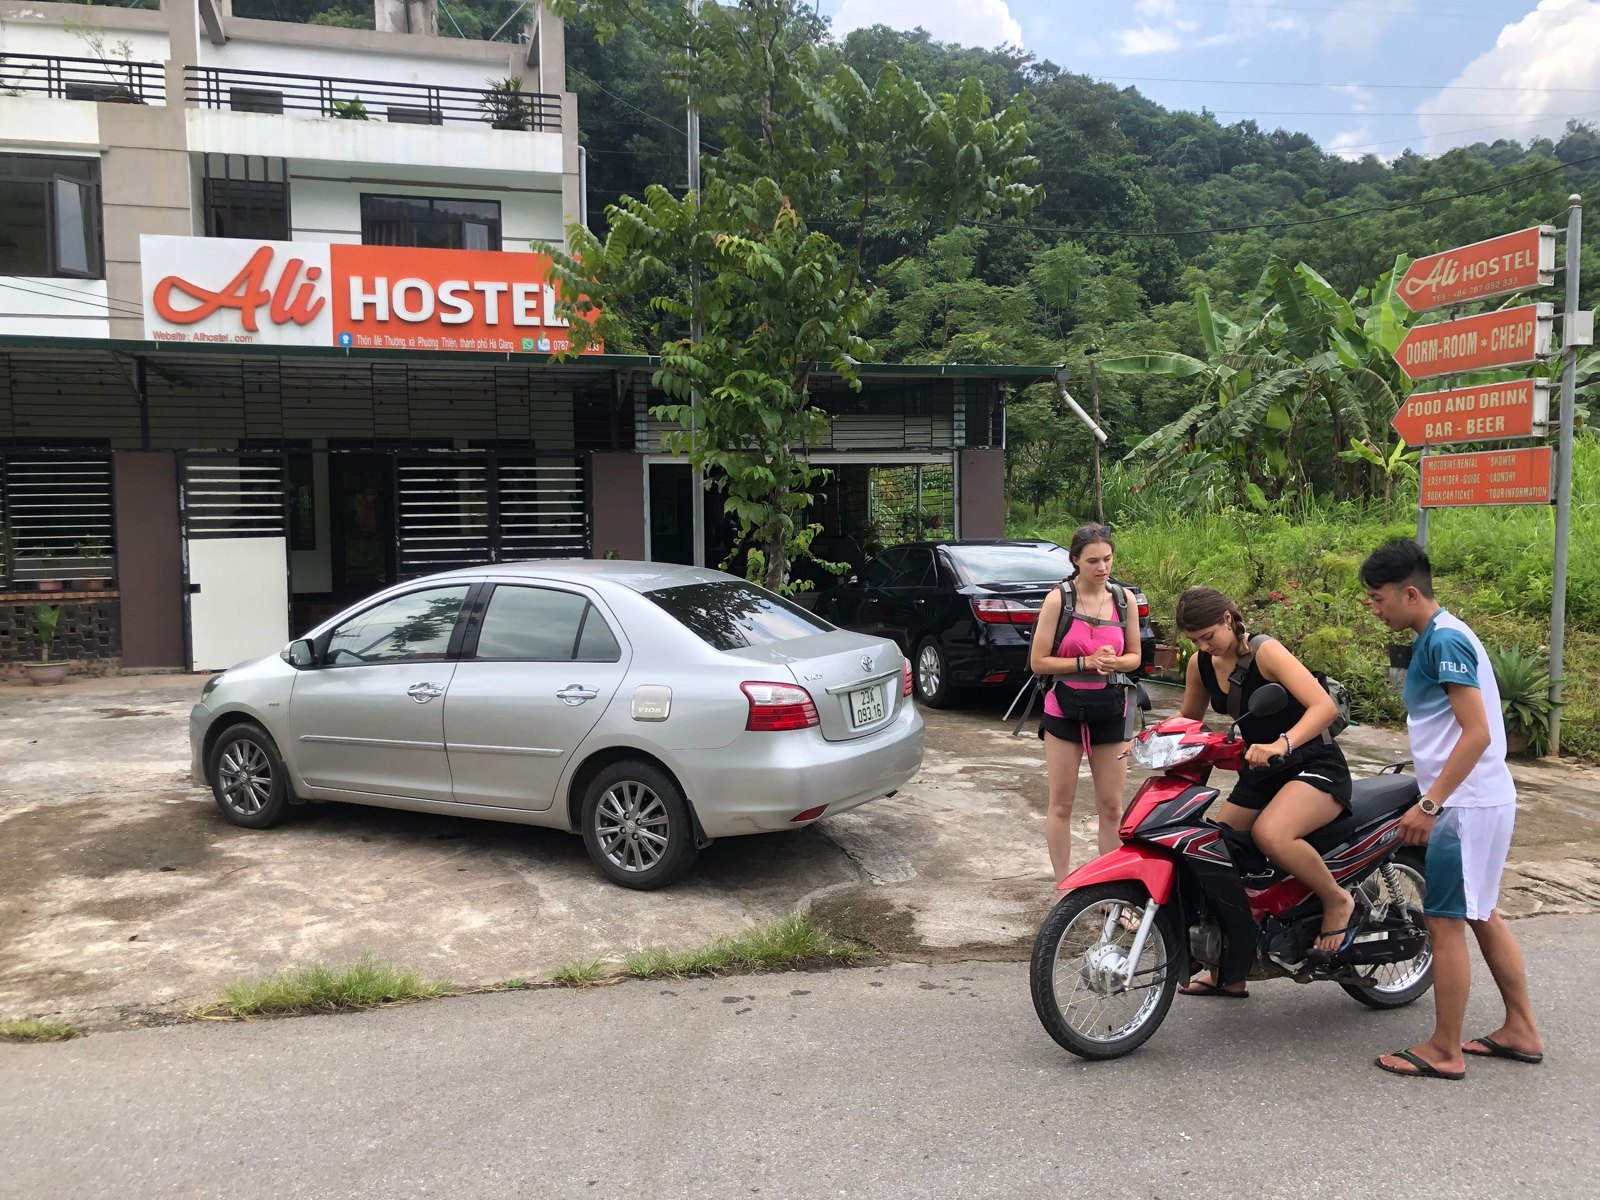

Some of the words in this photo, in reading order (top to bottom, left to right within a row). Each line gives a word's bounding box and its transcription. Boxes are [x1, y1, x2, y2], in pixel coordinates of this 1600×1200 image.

[1405, 257, 1460, 296] Ali
[1462, 249, 1535, 281] HOSTEL
[1502, 276, 1518, 288] 333
[153, 245, 326, 332] Ali
[348, 275, 570, 327] HOSTEL
[1406, 331, 1478, 365] DORM-ROOM
[1491, 321, 1533, 352] CHEAP
[1407, 399, 1441, 417] FOOD
[1445, 395, 1475, 413] AND
[1479, 387, 1528, 409] DRINK
[1425, 421, 1453, 438] BAR
[1466, 416, 1505, 435] BEER
[1490, 455, 1516, 467] SHOWER
[1490, 471, 1516, 483] LAUNDRY
[1442, 490, 1454, 500] CAR
[1489, 488, 1505, 499] TOUR
[1505, 486, 1547, 498] INFORMATION
[860, 686, 876, 706] 23A
[857, 703, 882, 723] 093.16
